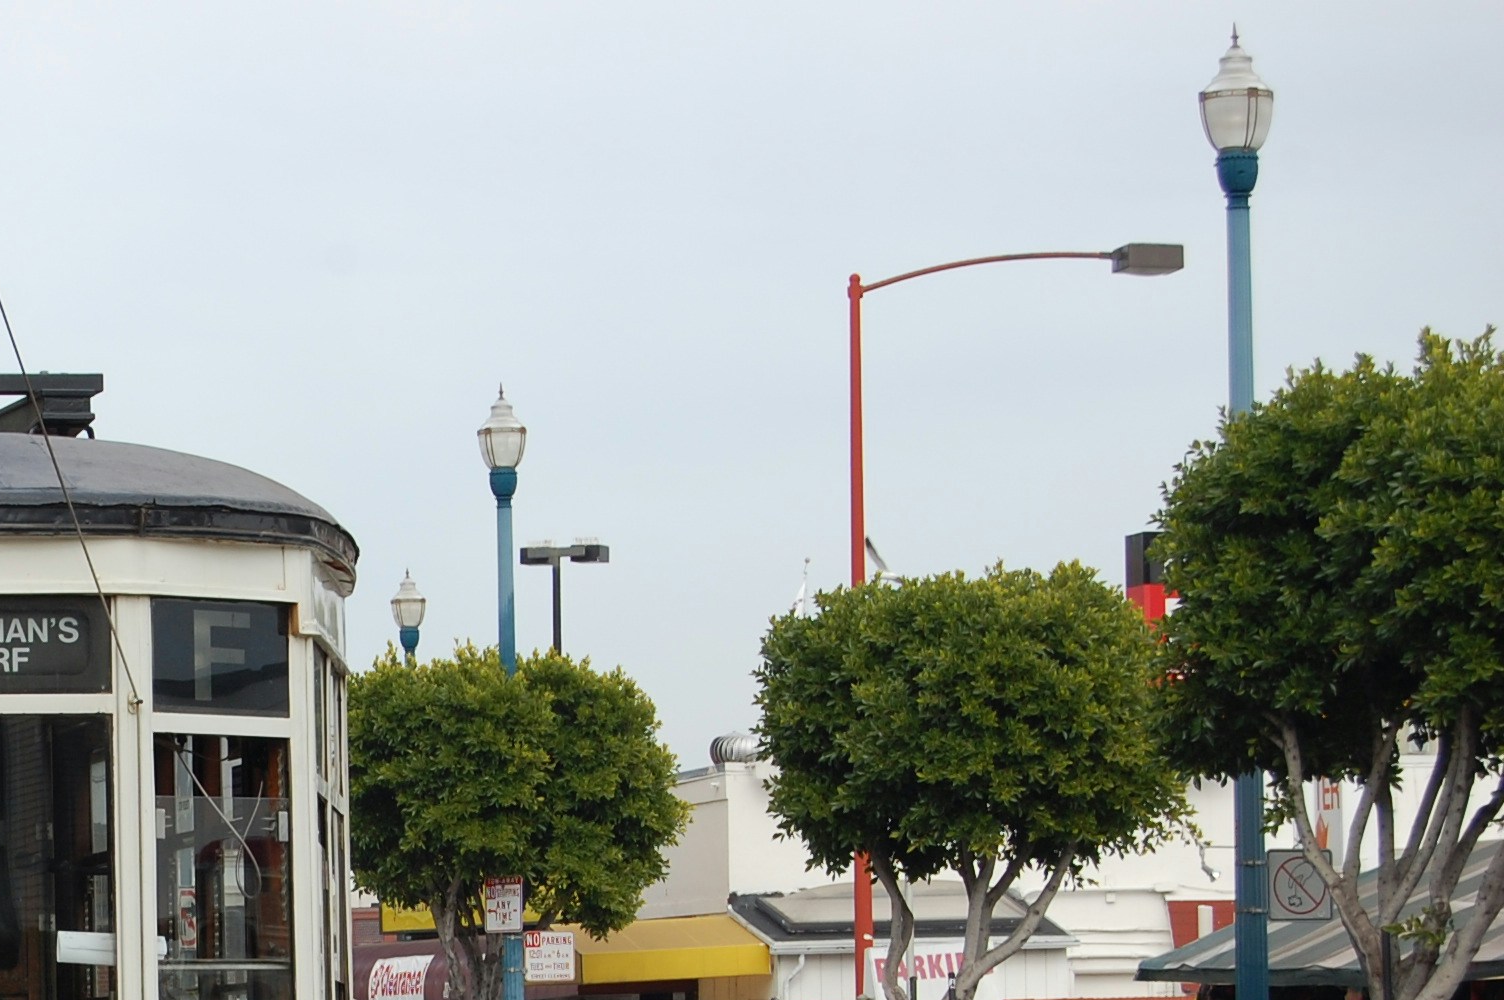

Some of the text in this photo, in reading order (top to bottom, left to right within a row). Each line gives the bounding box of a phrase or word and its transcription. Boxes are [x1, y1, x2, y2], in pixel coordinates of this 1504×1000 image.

[193, 609, 252, 702] F
[496, 901, 511, 910] ANY
[495, 911, 512, 921] TIME
[526, 933, 572, 947] NO PARKING
[874, 952, 994, 983] PARKI
